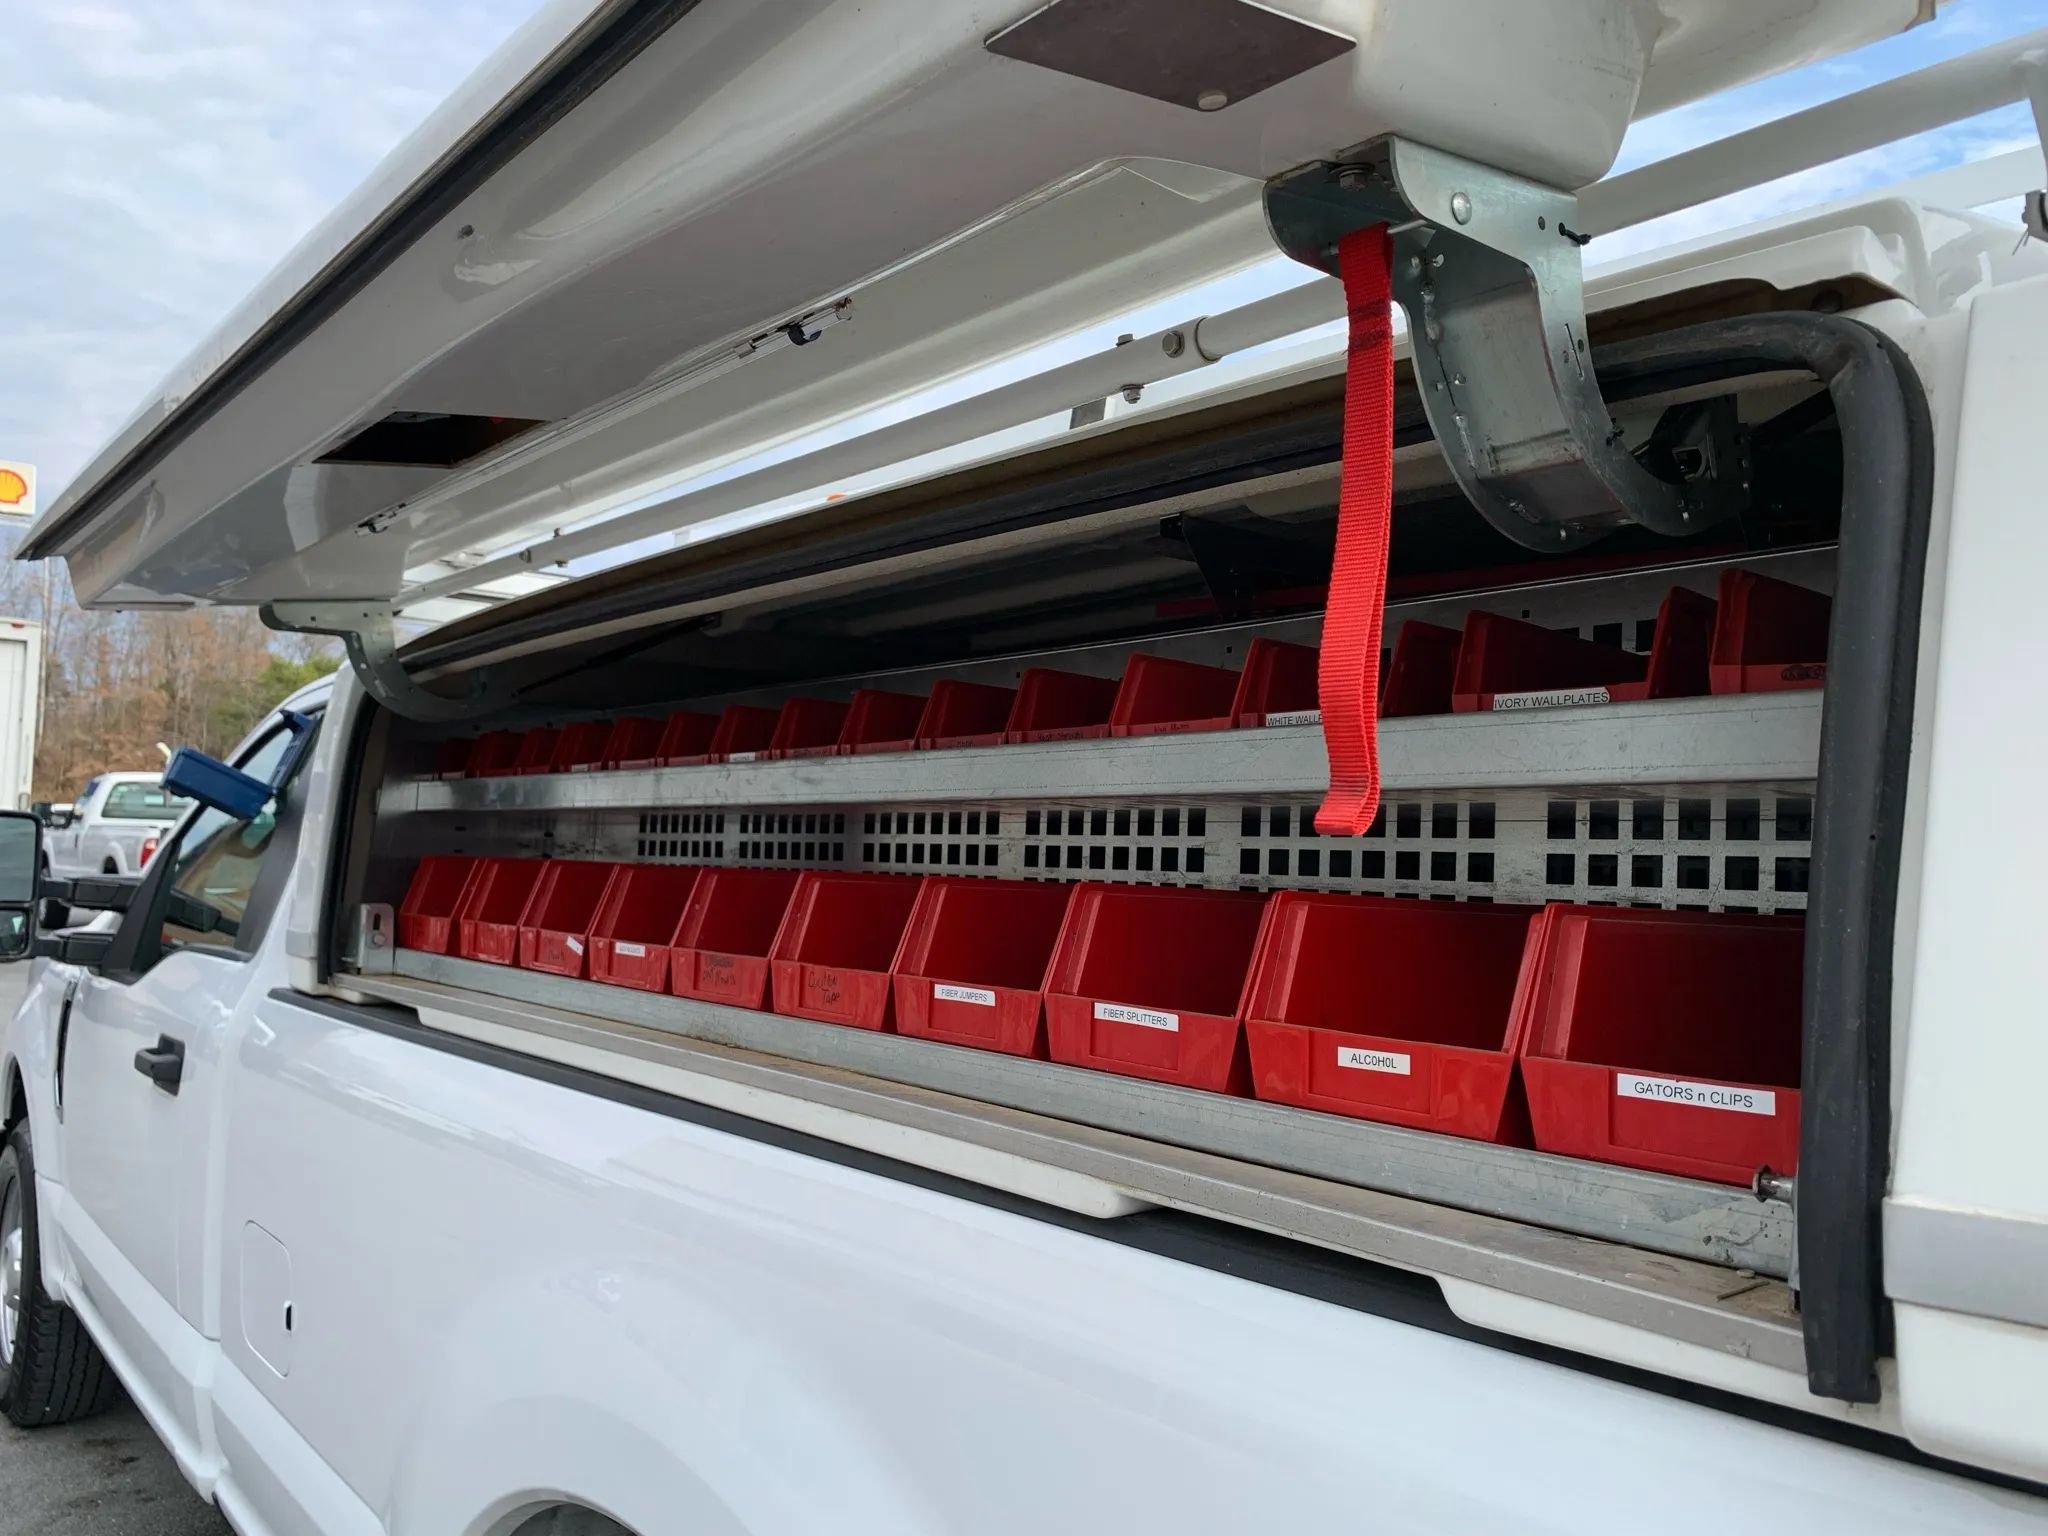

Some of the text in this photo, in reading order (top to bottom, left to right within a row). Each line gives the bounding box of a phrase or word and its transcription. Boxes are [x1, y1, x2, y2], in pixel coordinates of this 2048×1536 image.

[1494, 691, 1609, 709] IVORY WALLPLATES
[1267, 716, 1294, 727] WHITE
[941, 988, 988, 1002] FIBER JUMPERS
[1103, 1008, 1168, 1027] FIBER SPLITTERS
[1634, 1081, 1753, 1108] GATORS n CLIPS
